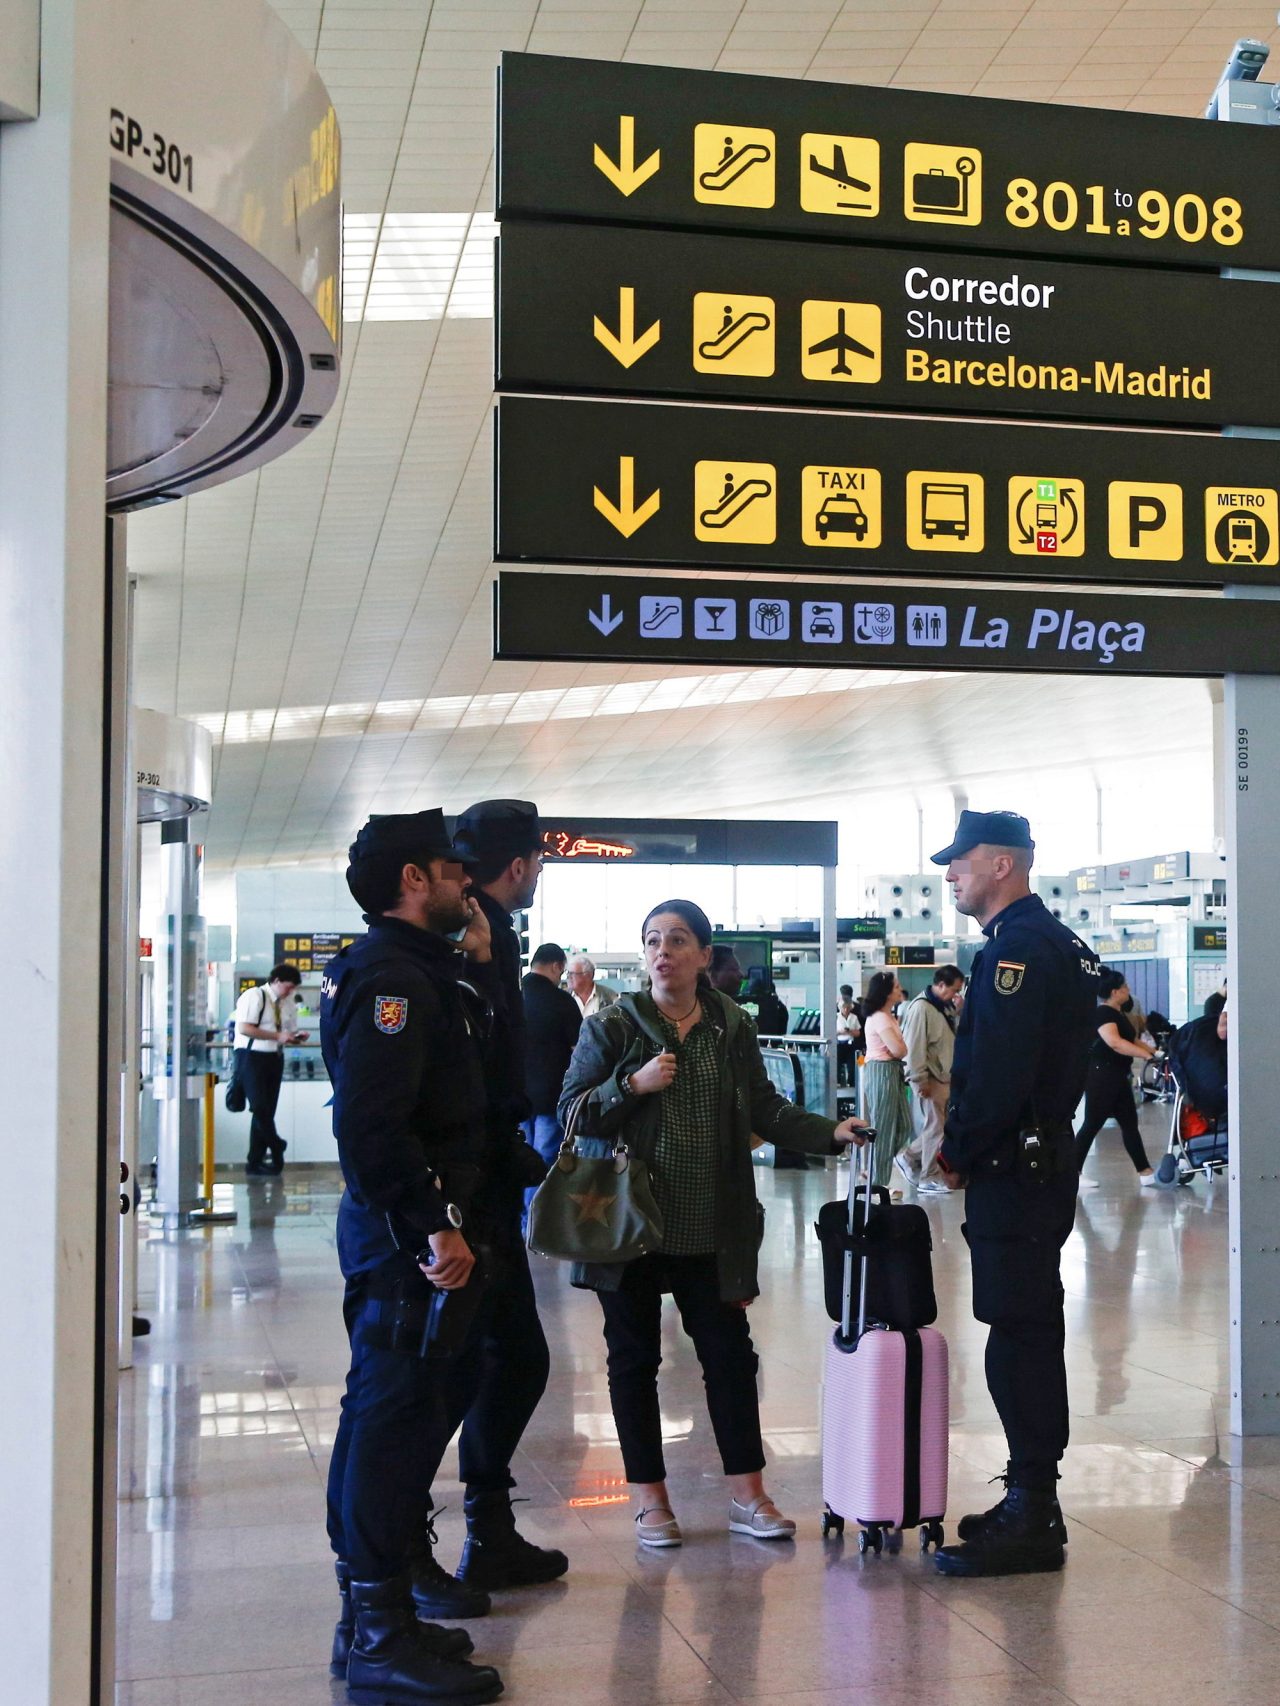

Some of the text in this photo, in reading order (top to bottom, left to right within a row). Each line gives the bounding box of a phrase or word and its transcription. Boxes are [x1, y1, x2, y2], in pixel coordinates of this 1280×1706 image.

[110, 108, 193, 193] GP-301
[1005, 177, 1244, 246] 801 to 908
[1116, 218, 1131, 237] a
[904, 266, 1055, 309] Corredor
[906, 309, 1011, 345] Shuttle
[905, 348, 1211, 400] Barcelona-Madrid
[817, 471, 866, 490] TAXI
[1039, 485, 1055, 497] T1
[1217, 493, 1265, 507] METRO
[1038, 536, 1056, 548] T2
[1129, 495, 1167, 548] P
[959, 606, 1146, 664] La Plaça
[1238, 728, 1249, 792] SE 00199
